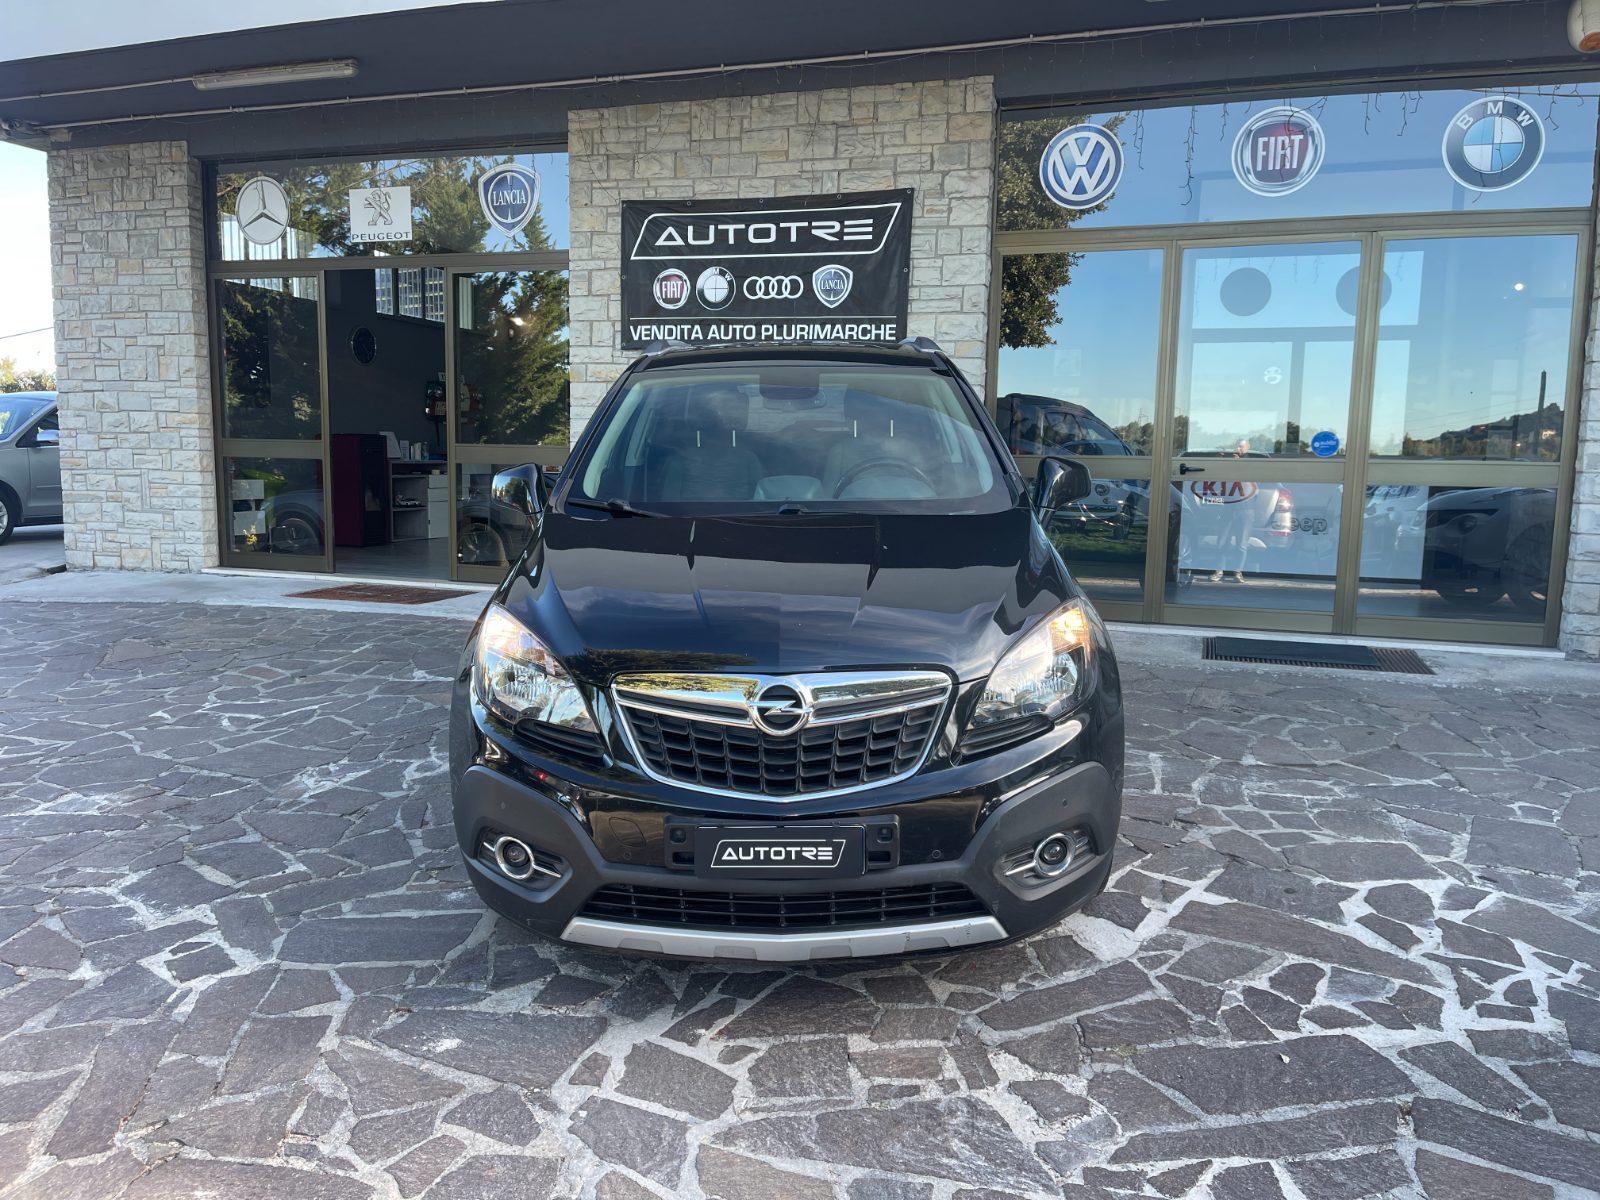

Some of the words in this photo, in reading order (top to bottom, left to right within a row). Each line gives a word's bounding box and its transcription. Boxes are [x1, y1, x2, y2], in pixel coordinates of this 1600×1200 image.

[1456, 102, 1534, 130] BMW
[1257, 134, 1304, 171] FIAT
[493, 190, 527, 206] LANCIA
[352, 231, 411, 241] PEUGEOT
[654, 218, 874, 246] AUTOTRE
[661, 280, 683, 299] FIAT
[820, 279, 845, 290] LANCIA
[630, 325, 703, 341] VENDITA
[706, 325, 757, 340] AUTO
[761, 324, 897, 340] PLURIMARCHE
[1202, 480, 1245, 497] KIA
[721, 846, 833, 861] AUTOTRE
